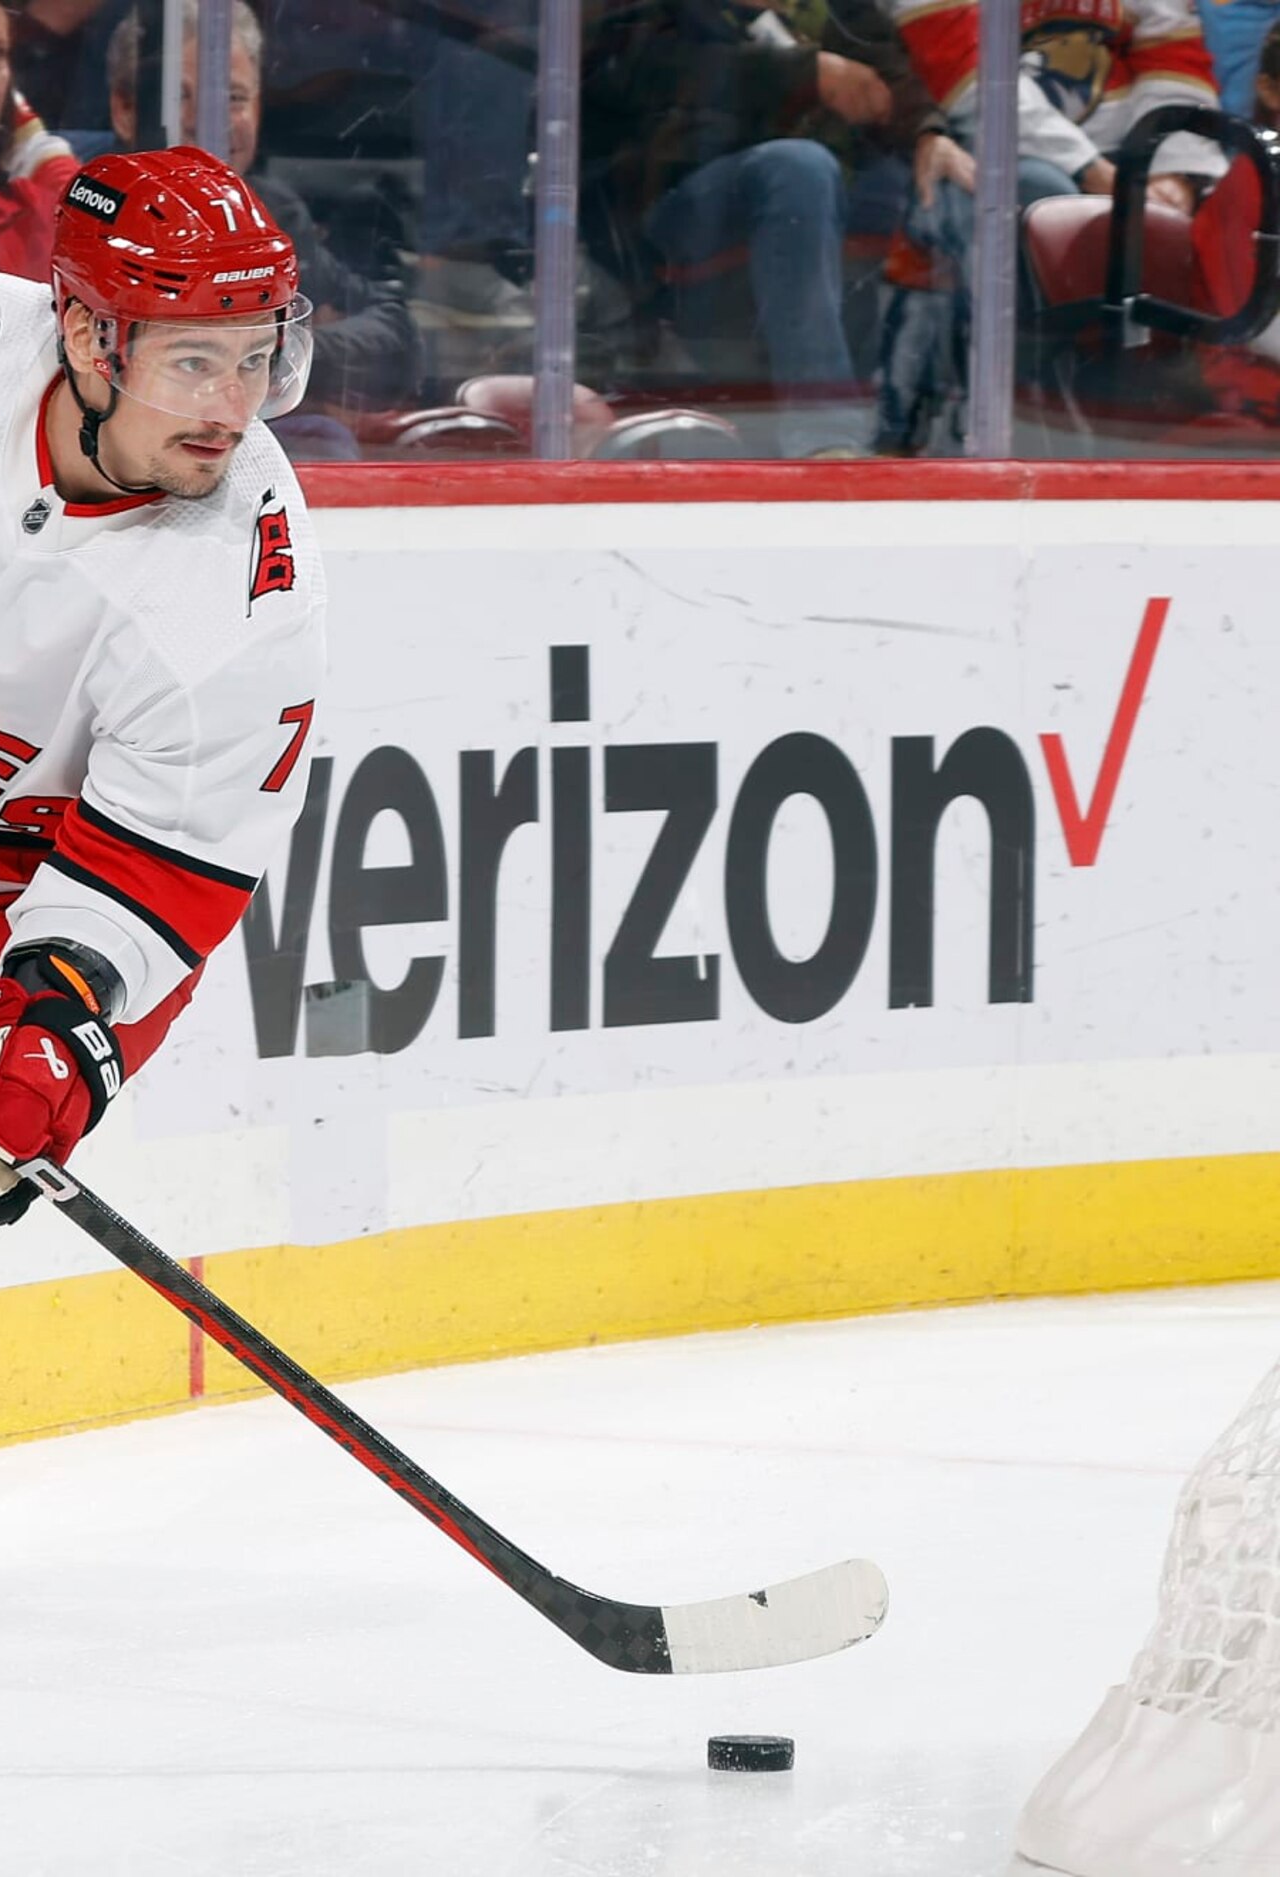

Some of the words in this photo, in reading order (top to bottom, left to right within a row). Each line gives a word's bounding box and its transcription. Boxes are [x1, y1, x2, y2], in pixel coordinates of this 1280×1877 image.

[69, 178, 117, 215] Lenovo
[210, 199, 238, 232] 7
[259, 698, 315, 792] 7
[242, 645, 1037, 1060] verizon
